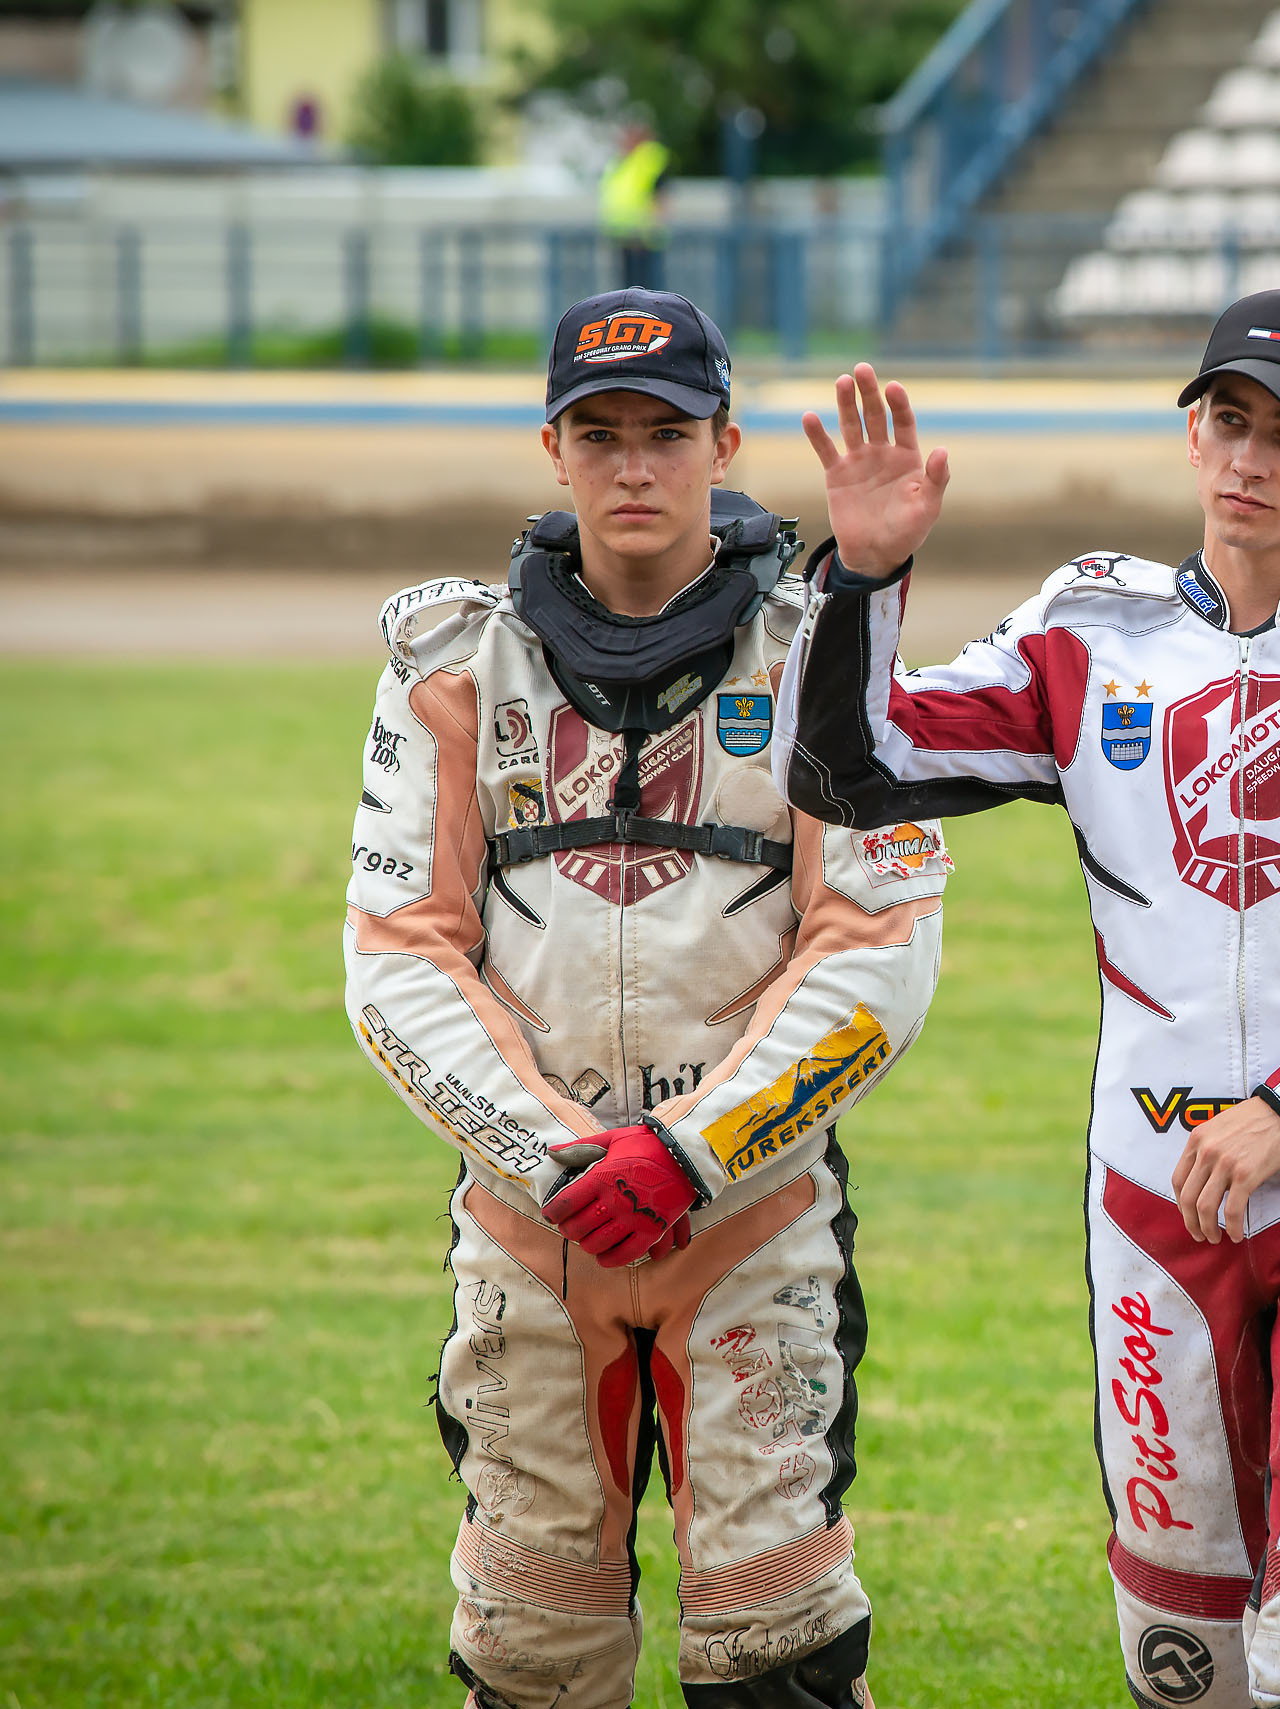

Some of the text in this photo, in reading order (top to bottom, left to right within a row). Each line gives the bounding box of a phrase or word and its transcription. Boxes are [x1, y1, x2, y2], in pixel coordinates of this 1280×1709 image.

[576, 317, 673, 354] SGP
[583, 347, 611, 359] SPEEDWAY
[611, 344, 632, 352] GRAND
[632, 344, 647, 352] PRIX
[725, 1040, 888, 1182] TUREKSPERT
